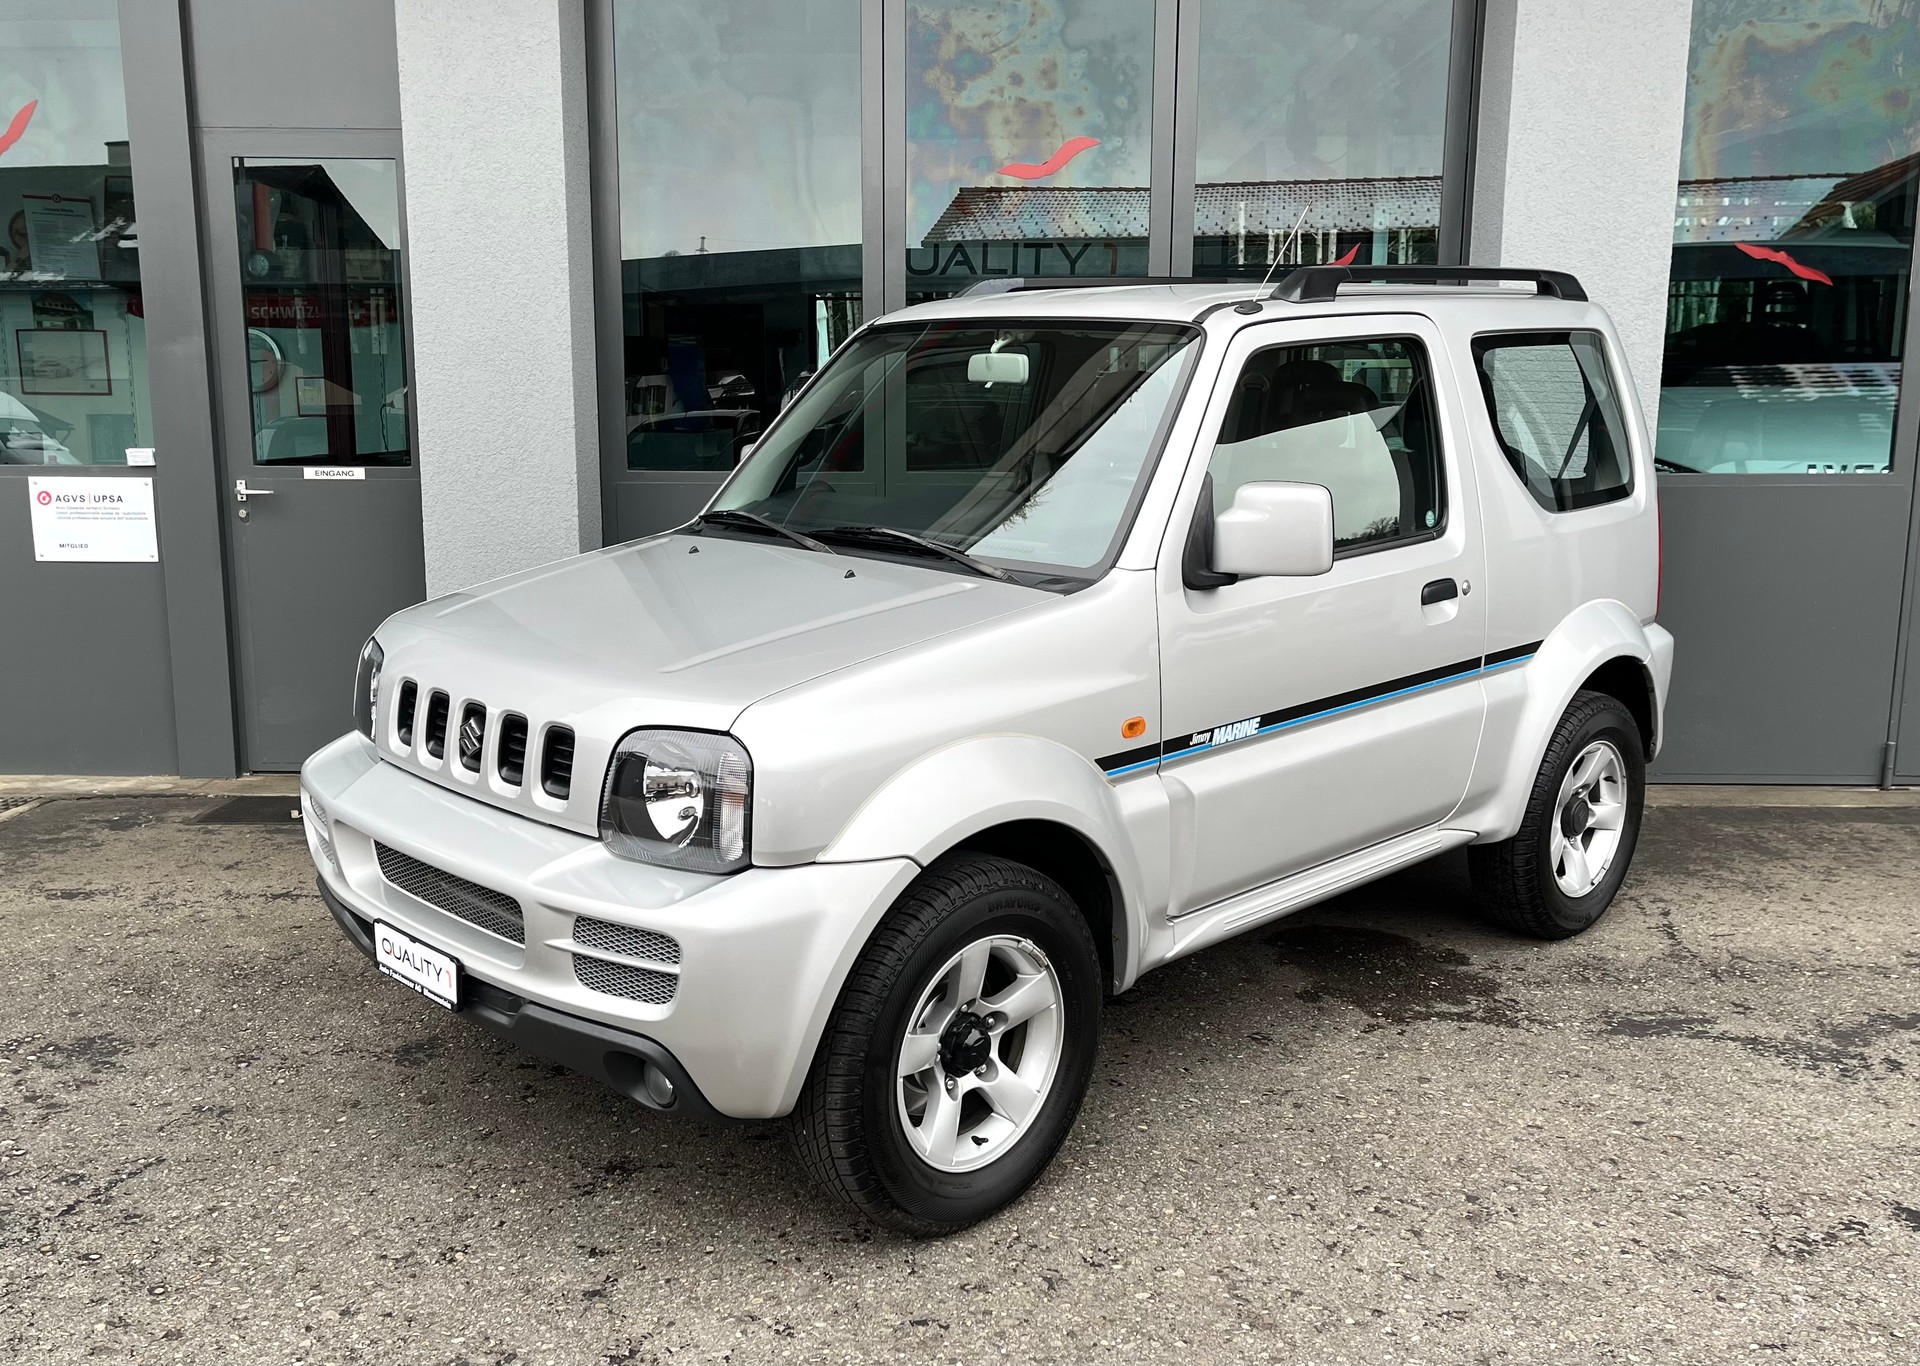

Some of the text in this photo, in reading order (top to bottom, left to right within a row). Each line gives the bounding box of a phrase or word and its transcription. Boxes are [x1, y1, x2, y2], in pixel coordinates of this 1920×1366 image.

[314, 469, 355, 477] EINGANG
[55, 494, 124, 503] AGVS UPSA
[1189, 716, 1262, 747] Jimny MARINE
